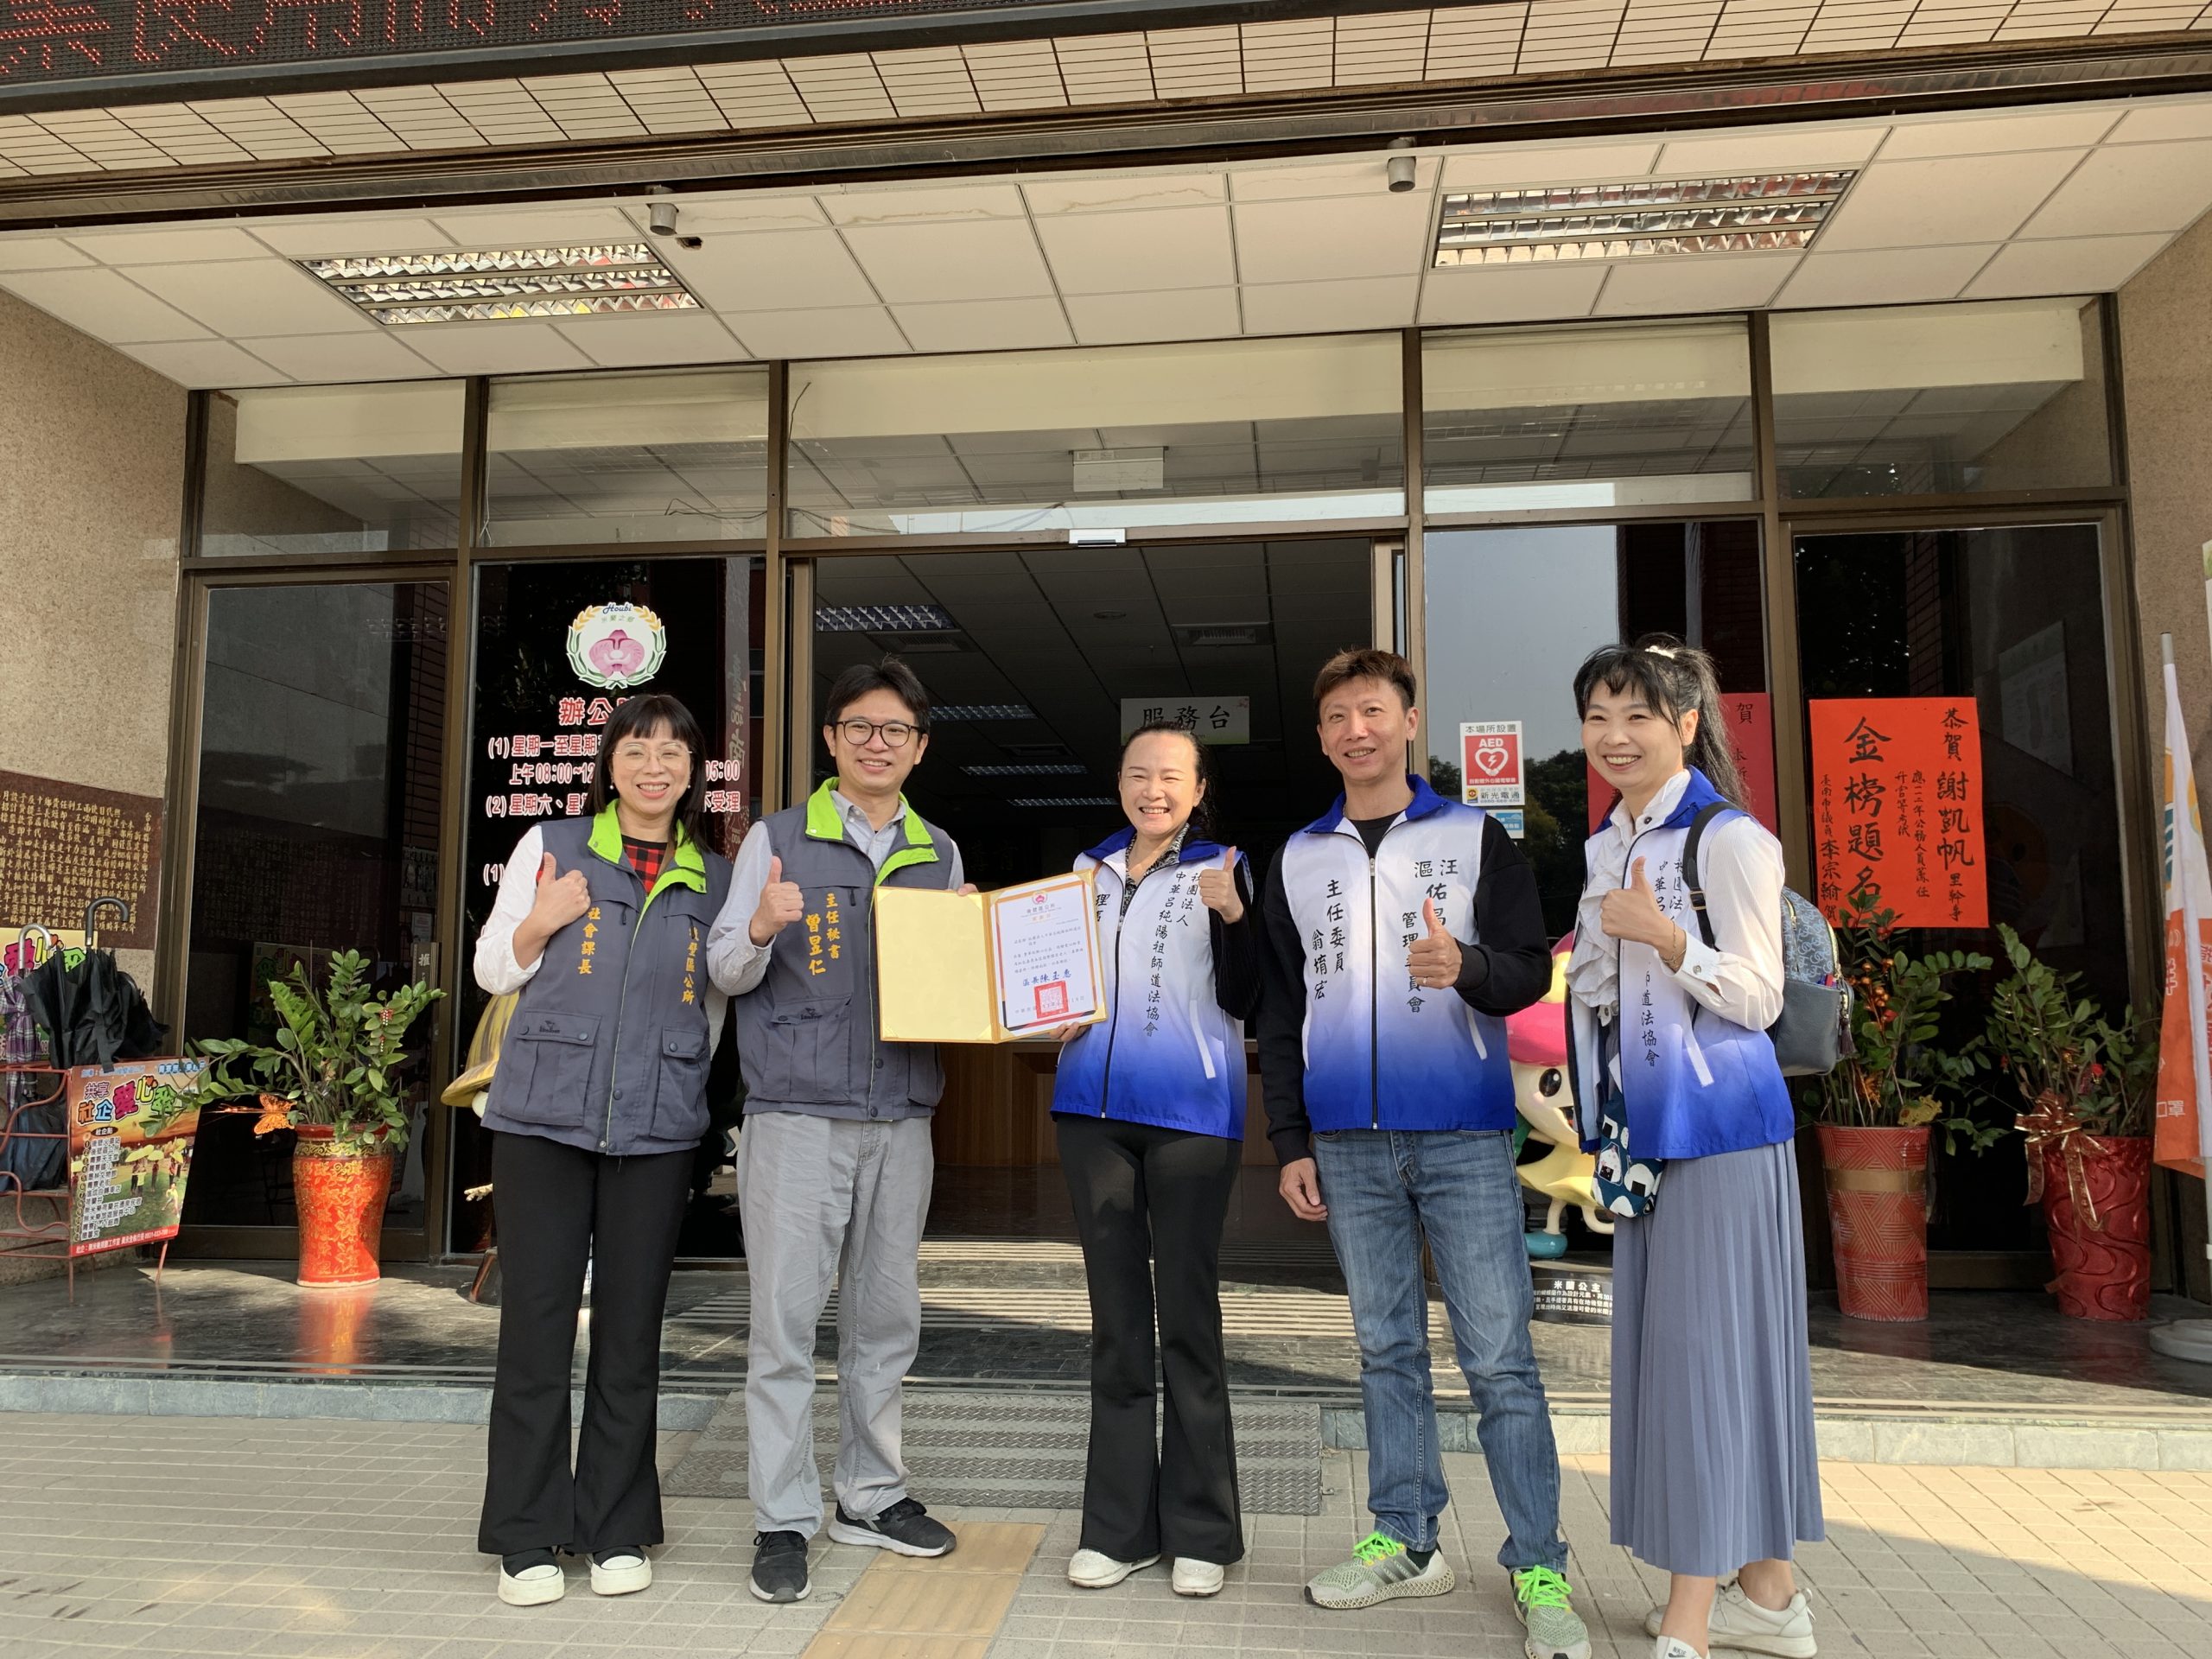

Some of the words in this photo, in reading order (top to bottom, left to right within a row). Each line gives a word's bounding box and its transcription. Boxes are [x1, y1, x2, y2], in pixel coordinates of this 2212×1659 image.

[602, 604, 632, 614] Houbi
[1142, 705, 1230, 730] 服務台
[1735, 702, 1755, 725] 賀
[1465, 723, 1517, 734] 本場所設置
[1478, 737, 1503, 748] AED
[1843, 715, 1892, 899] 金榜題名
[825, 893, 842, 960] 主任秘書
[1325, 880, 1346, 975] 主任委員
[577, 906, 602, 976] 社會課長
[804, 913, 827, 976] 曾昱仁
[1142, 870, 1187, 1038] 中華呂純陽祖師道法協會
[418, 953, 431, 967] 推
[1402, 911, 1426, 1014] 管理員會
[84, 1081, 111, 1099] 共享
[77, 1098, 114, 1124] 社企
